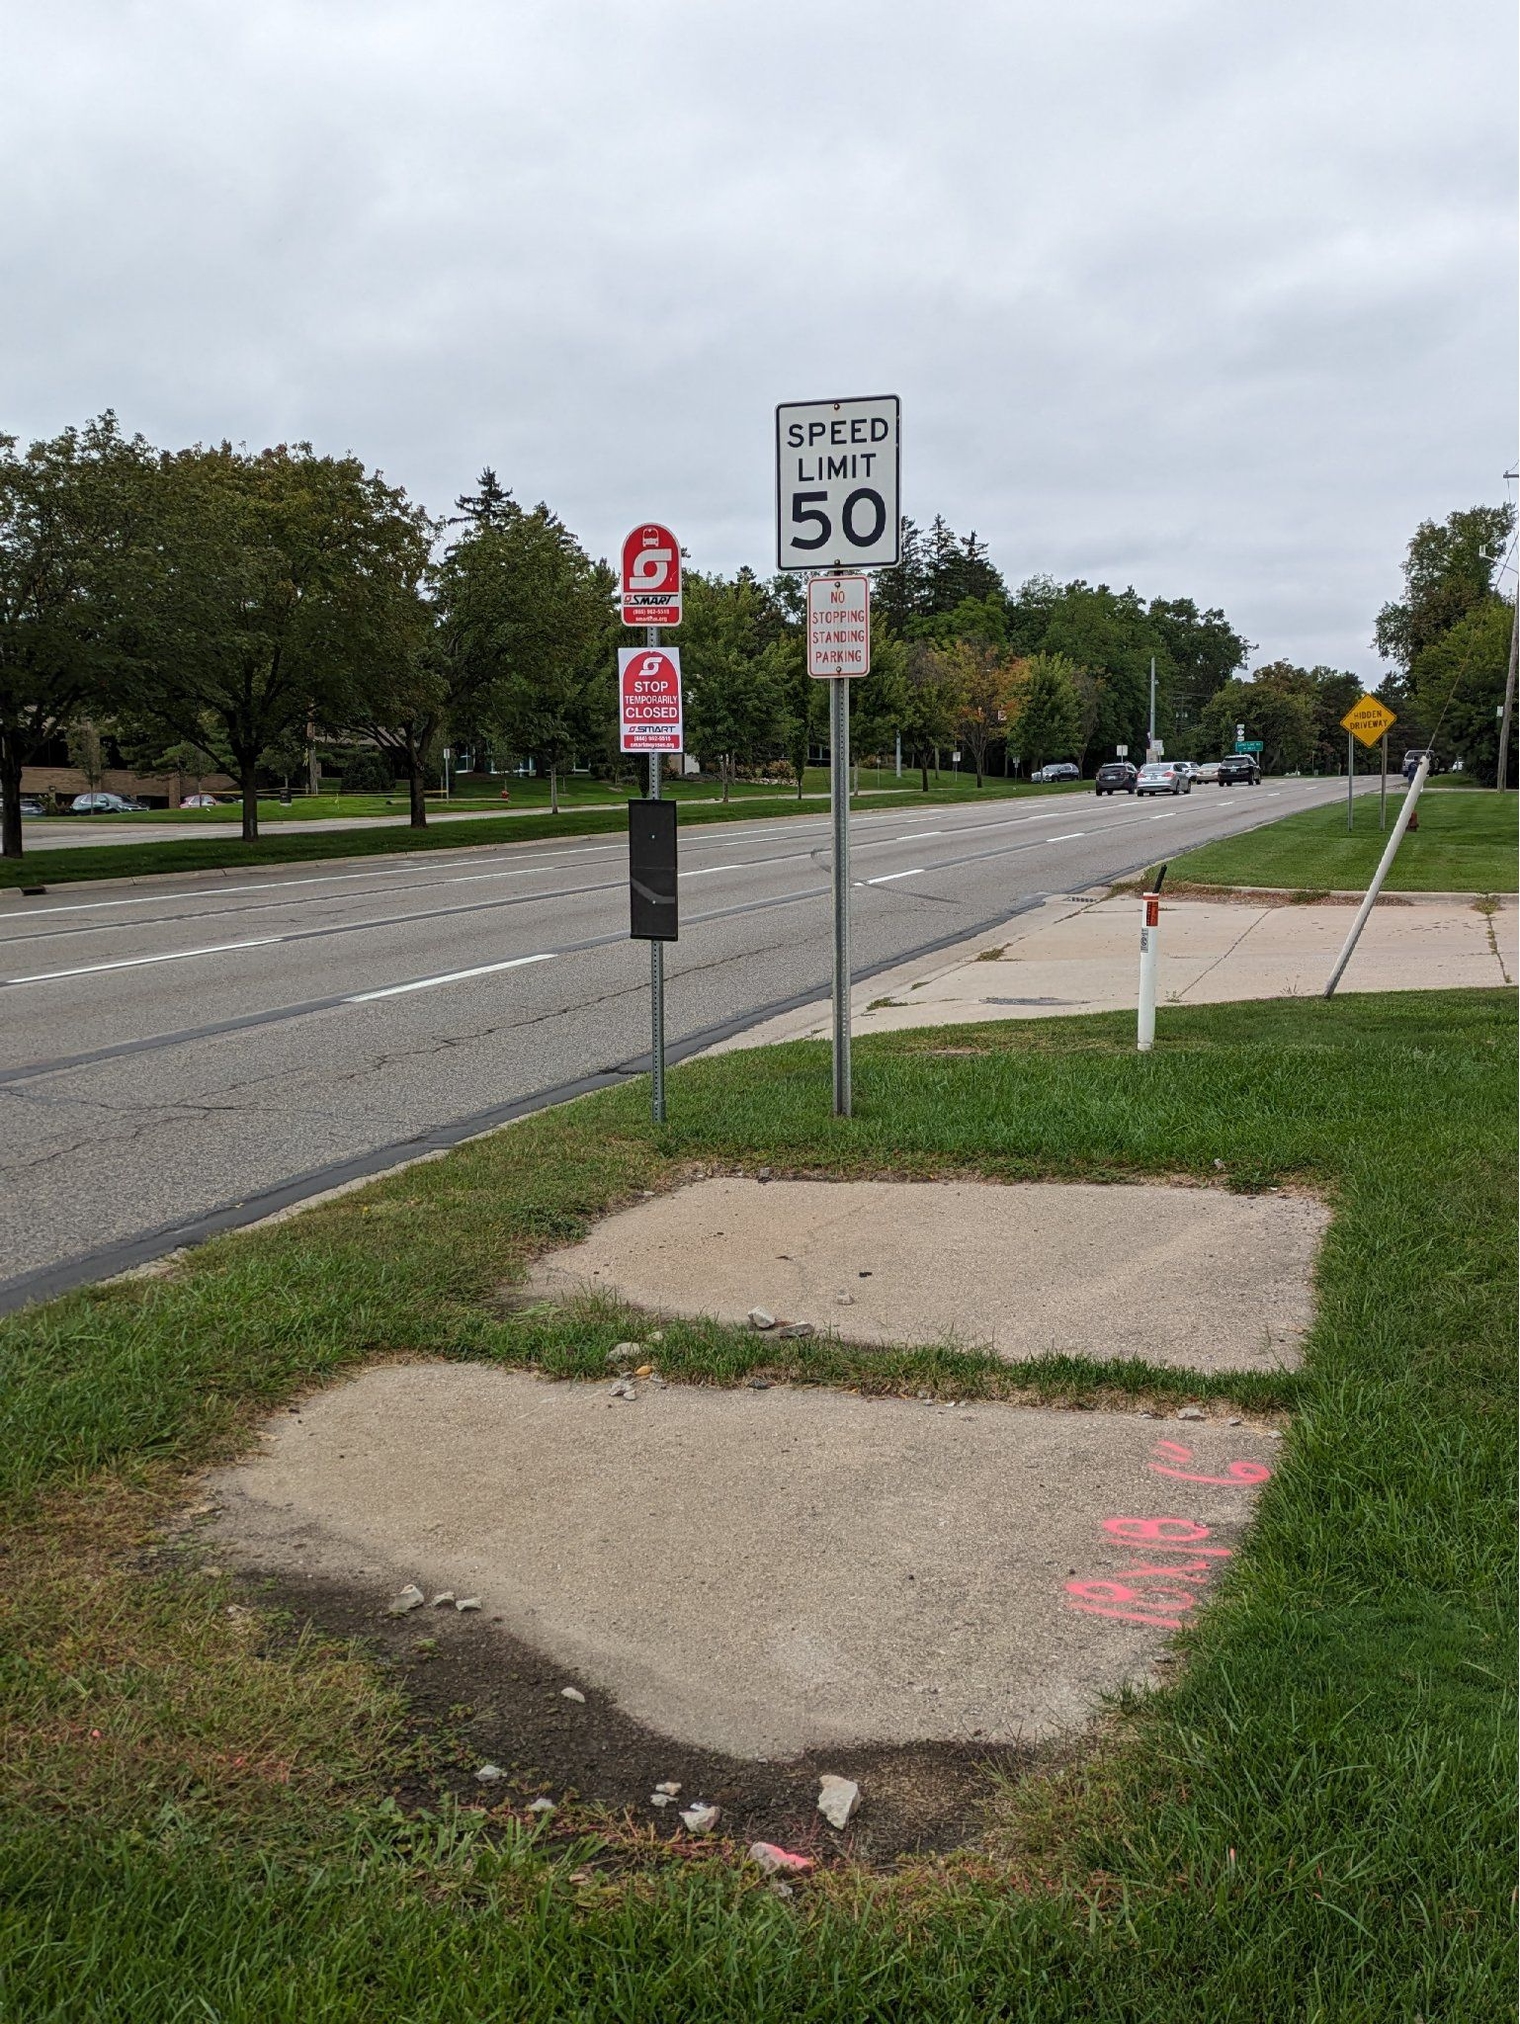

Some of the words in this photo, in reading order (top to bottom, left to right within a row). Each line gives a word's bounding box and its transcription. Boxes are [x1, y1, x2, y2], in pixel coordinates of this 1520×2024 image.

[787, 417, 889, 448] SPEED
[798, 453, 876, 482] LIMIT
[790, 487, 886, 550] 50
[630, 594, 678, 605] SMART
[830, 590, 845, 603] NO
[811, 610, 865, 624] STOPPING
[812, 630, 865, 644] STANDING
[815, 650, 862, 663] PARKING
[634, 681, 668, 692] STOP
[624, 695, 678, 704] TEMPORARILY
[625, 707, 677, 718] CLOSED
[1353, 710, 1382, 720] HIDDEN
[1349, 719, 1388, 730] DRIVEWAY
